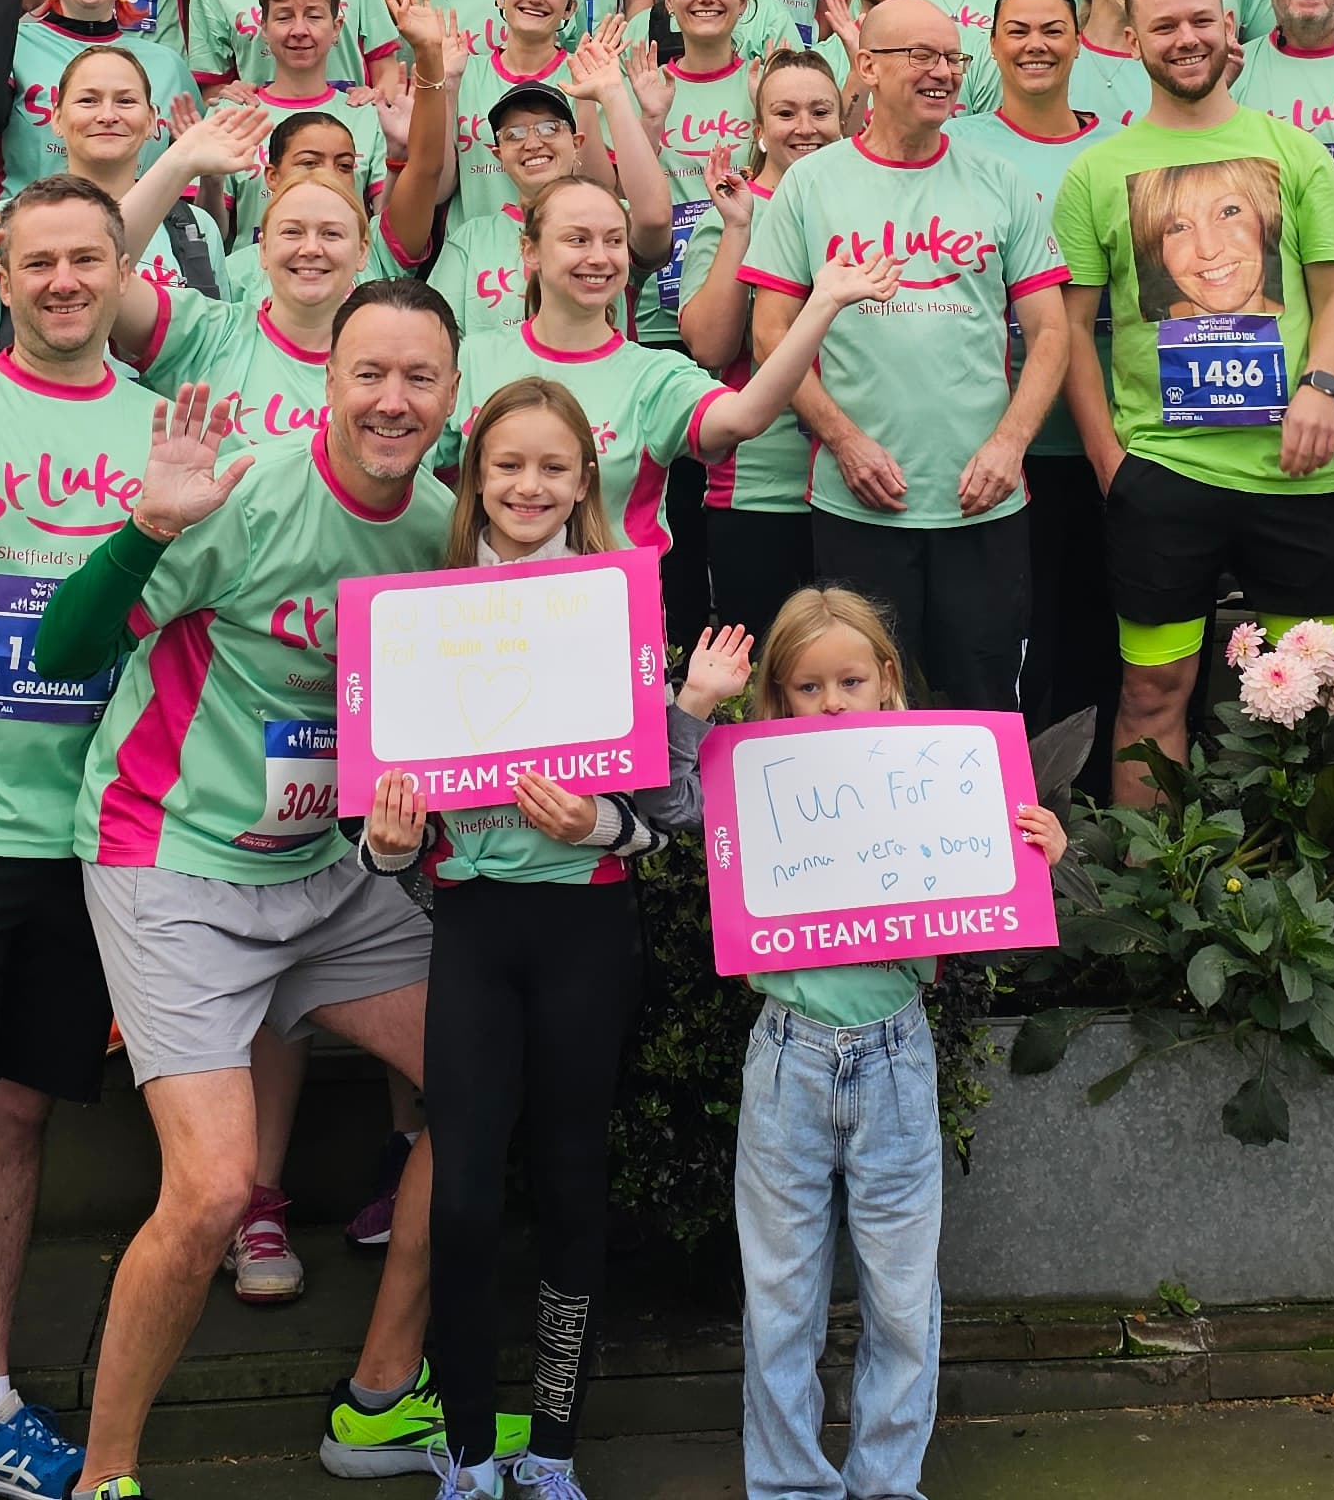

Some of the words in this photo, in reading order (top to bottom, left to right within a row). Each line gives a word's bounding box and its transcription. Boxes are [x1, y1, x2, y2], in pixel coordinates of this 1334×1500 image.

[681, 109, 750, 143] Luke
[882, 215, 997, 274] Luke's
[858, 301, 924, 316] Sheffield's
[927, 302, 973, 315] Hospice
[1197, 331, 1242, 342] SHEFFIELD
[1187, 359, 1264, 388] 1486
[1210, 393, 1245, 405] BRAD
[270, 596, 329, 650] St
[12, 680, 84, 697] GRAHAM
[312, 736, 335, 749] RUN
[424, 765, 499, 794] TEAM
[543, 749, 634, 781] LUKE'S
[750, 927, 795, 955] GO
[799, 918, 877, 950] TEAM
[883, 914, 917, 941] ST
[923, 906, 1020, 938] LUKE'S
